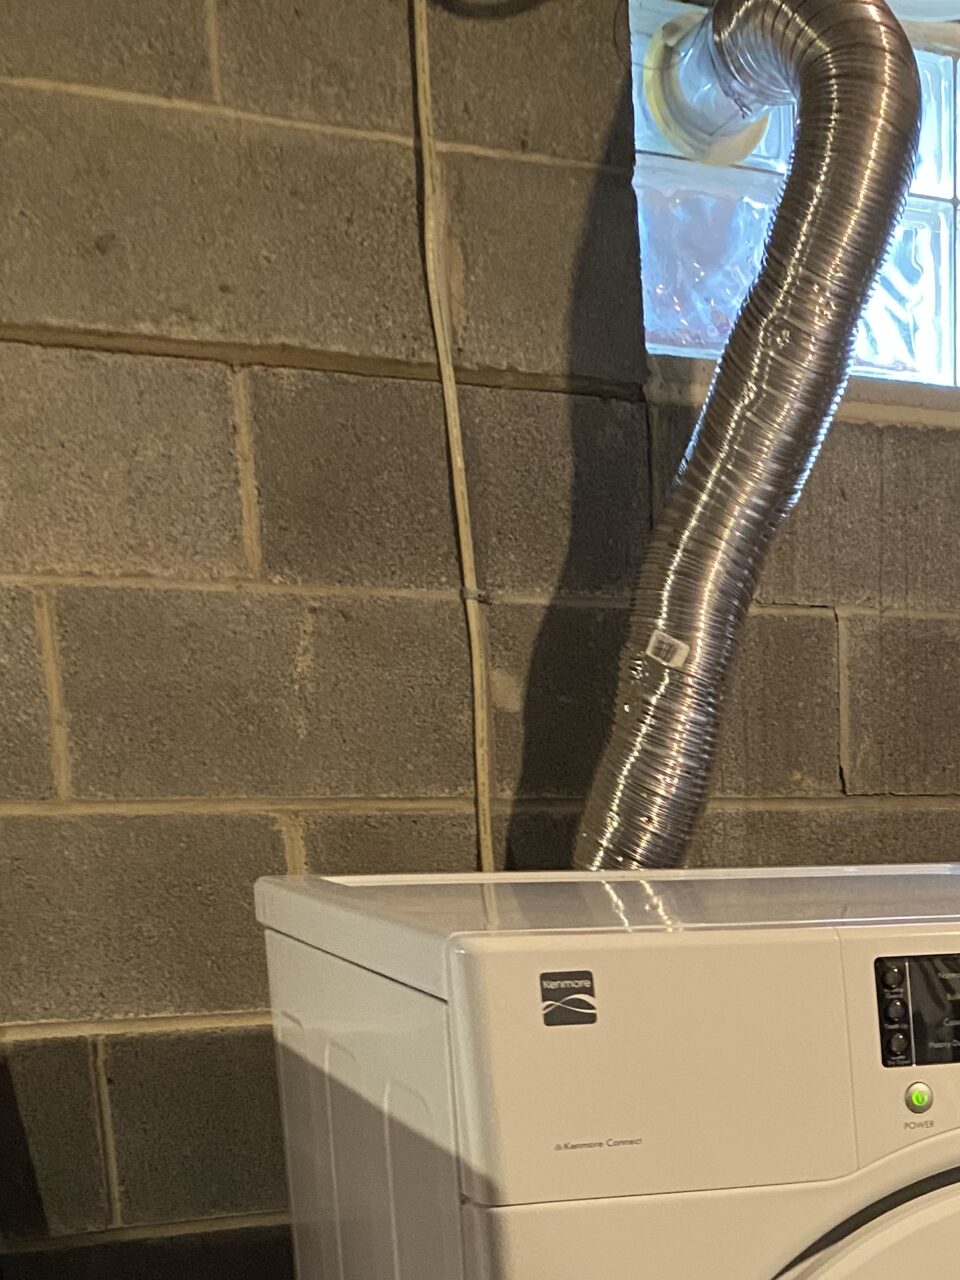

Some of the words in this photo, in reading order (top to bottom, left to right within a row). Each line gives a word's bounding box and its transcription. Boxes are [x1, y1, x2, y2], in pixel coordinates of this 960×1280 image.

[543, 979, 592, 989] Kenmore
[903, 1121, 935, 1130] POWER
[563, 1140, 604, 1151] Kenmore
[605, 1138, 643, 1147] Connect
